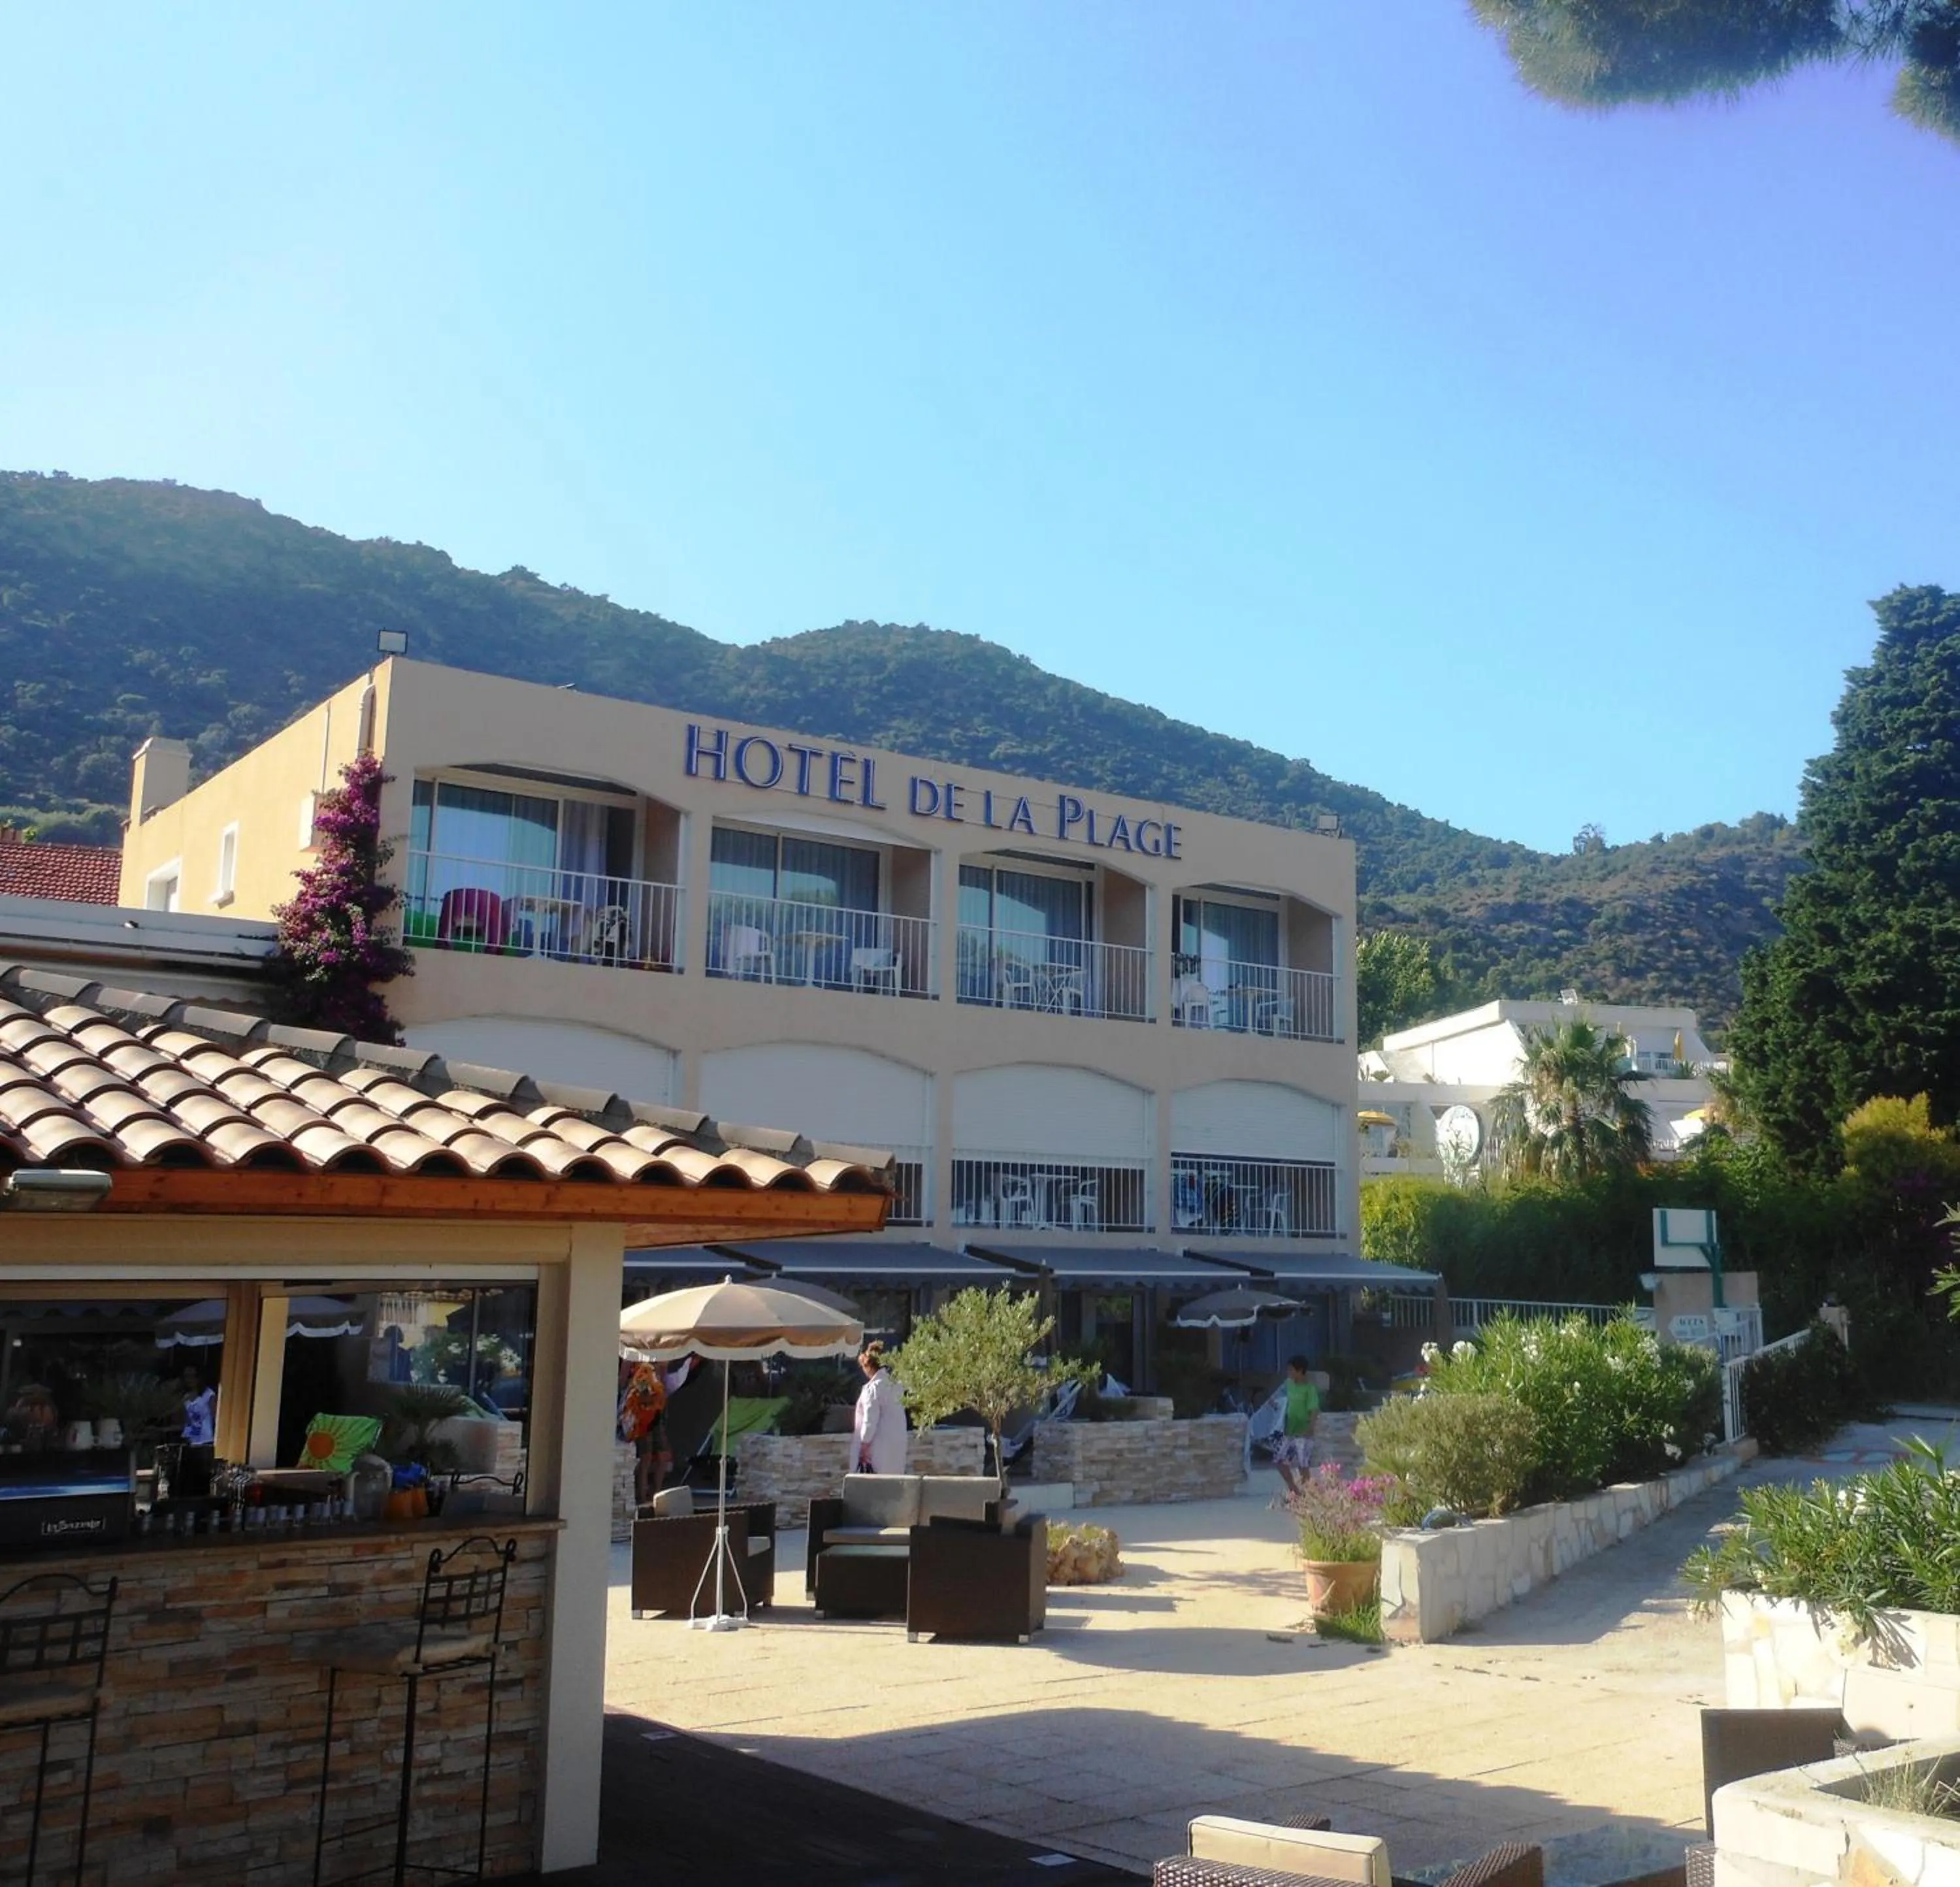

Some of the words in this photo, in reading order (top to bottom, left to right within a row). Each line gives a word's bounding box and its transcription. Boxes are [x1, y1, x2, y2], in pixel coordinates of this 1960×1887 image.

[909, 776, 965, 822] DE
[985, 790, 1037, 835] LA
[1058, 794, 1182, 861] PLAGE
